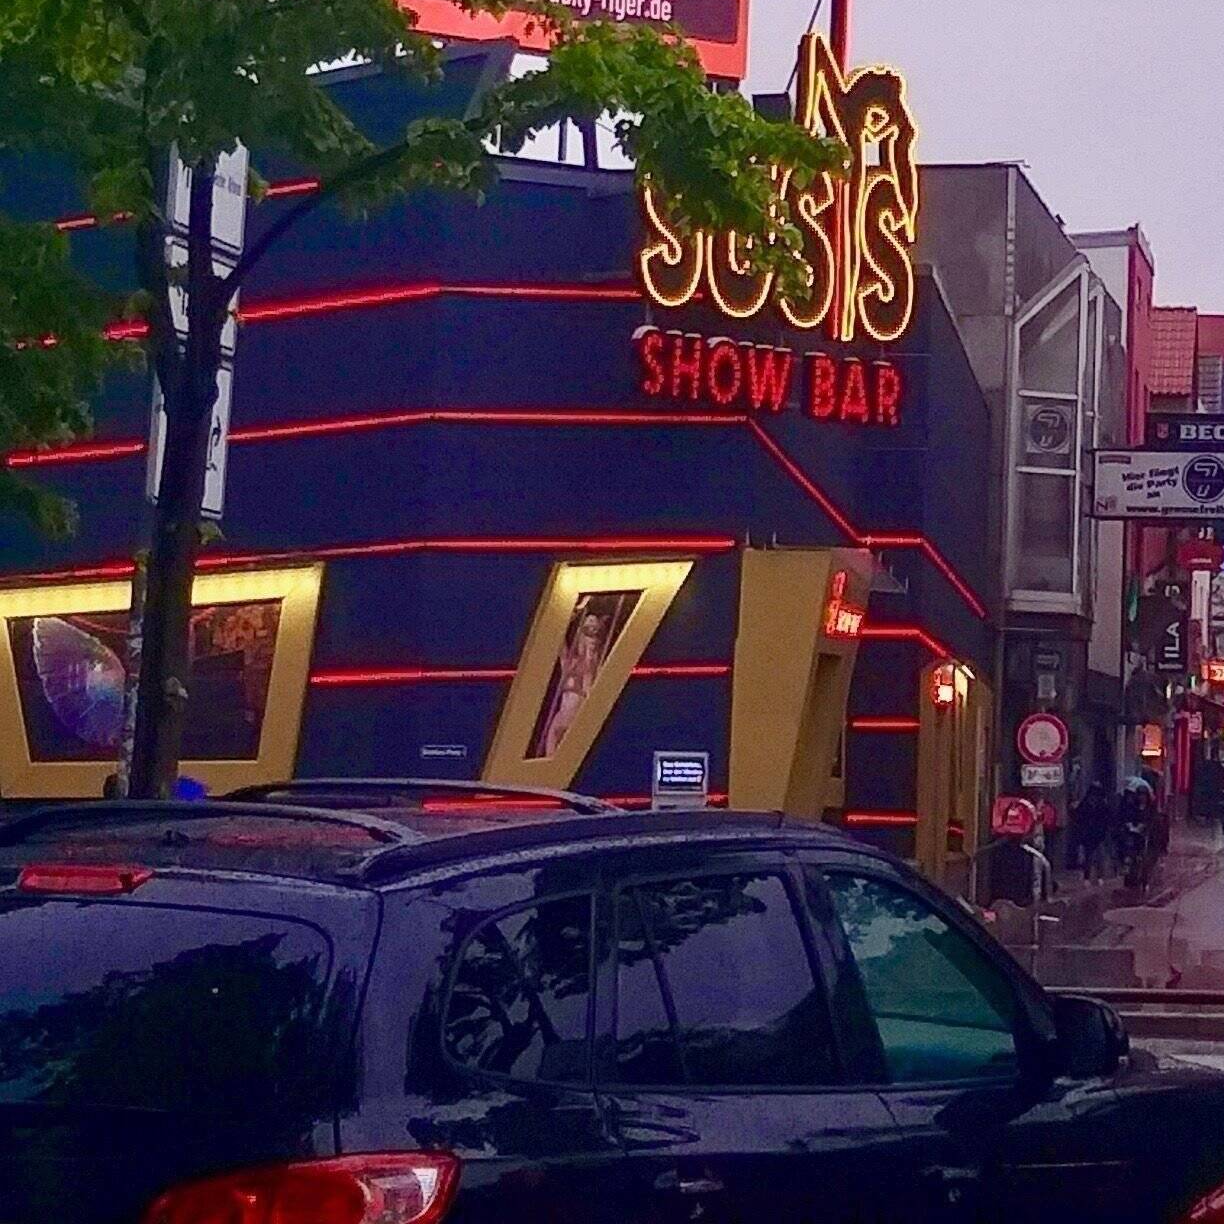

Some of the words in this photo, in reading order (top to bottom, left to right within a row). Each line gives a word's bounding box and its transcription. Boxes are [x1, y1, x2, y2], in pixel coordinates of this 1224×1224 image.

[632, 326, 793, 411] SHOW
[805, 352, 901, 426] BAR
[1147, 478, 1177, 489] Party
